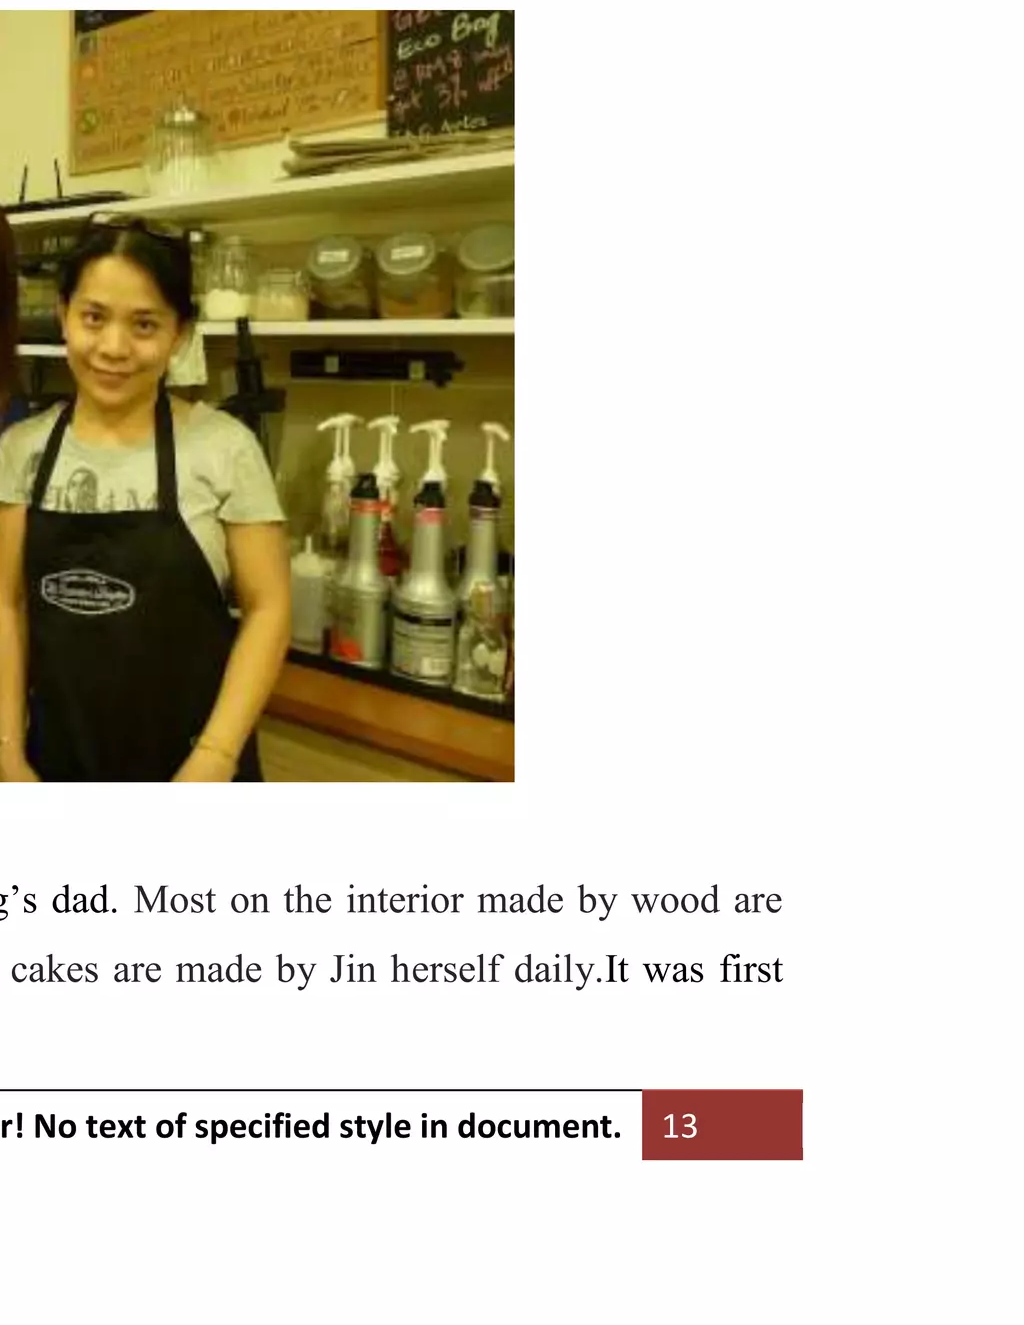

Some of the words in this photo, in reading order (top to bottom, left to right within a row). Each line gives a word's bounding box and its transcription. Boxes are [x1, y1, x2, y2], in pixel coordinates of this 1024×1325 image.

[53, 884, 116, 913] dad.
[135, 886, 216, 913] Most
[231, 894, 270, 913] on
[284, 884, 331, 913] the
[347, 884, 464, 913] interior
[478, 884, 563, 913] made
[578, 884, 617, 921] by
[631, 884, 720, 913] wood
[735, 894, 782, 913] are
[12, 954, 98, 982] cakes
[114, 963, 161, 982] are
[176, 954, 261, 982] made
[276, 954, 316, 991] by
[330, 954, 376, 982] Jin
[391, 954, 504, 982] herself
[643, 963, 703, 982] was
[720, 954, 783, 983] first
[35, 1114, 76, 1138] No
[86, 1116, 146, 1138] text
[156, 1112, 187, 1138] of
[196, 1112, 329, 1144] specified
[340, 1112, 411, 1144] style
[422, 1113, 447, 1138] in
[458, 1112, 620, 1138] document.
[664, 1114, 697, 1138] 13
